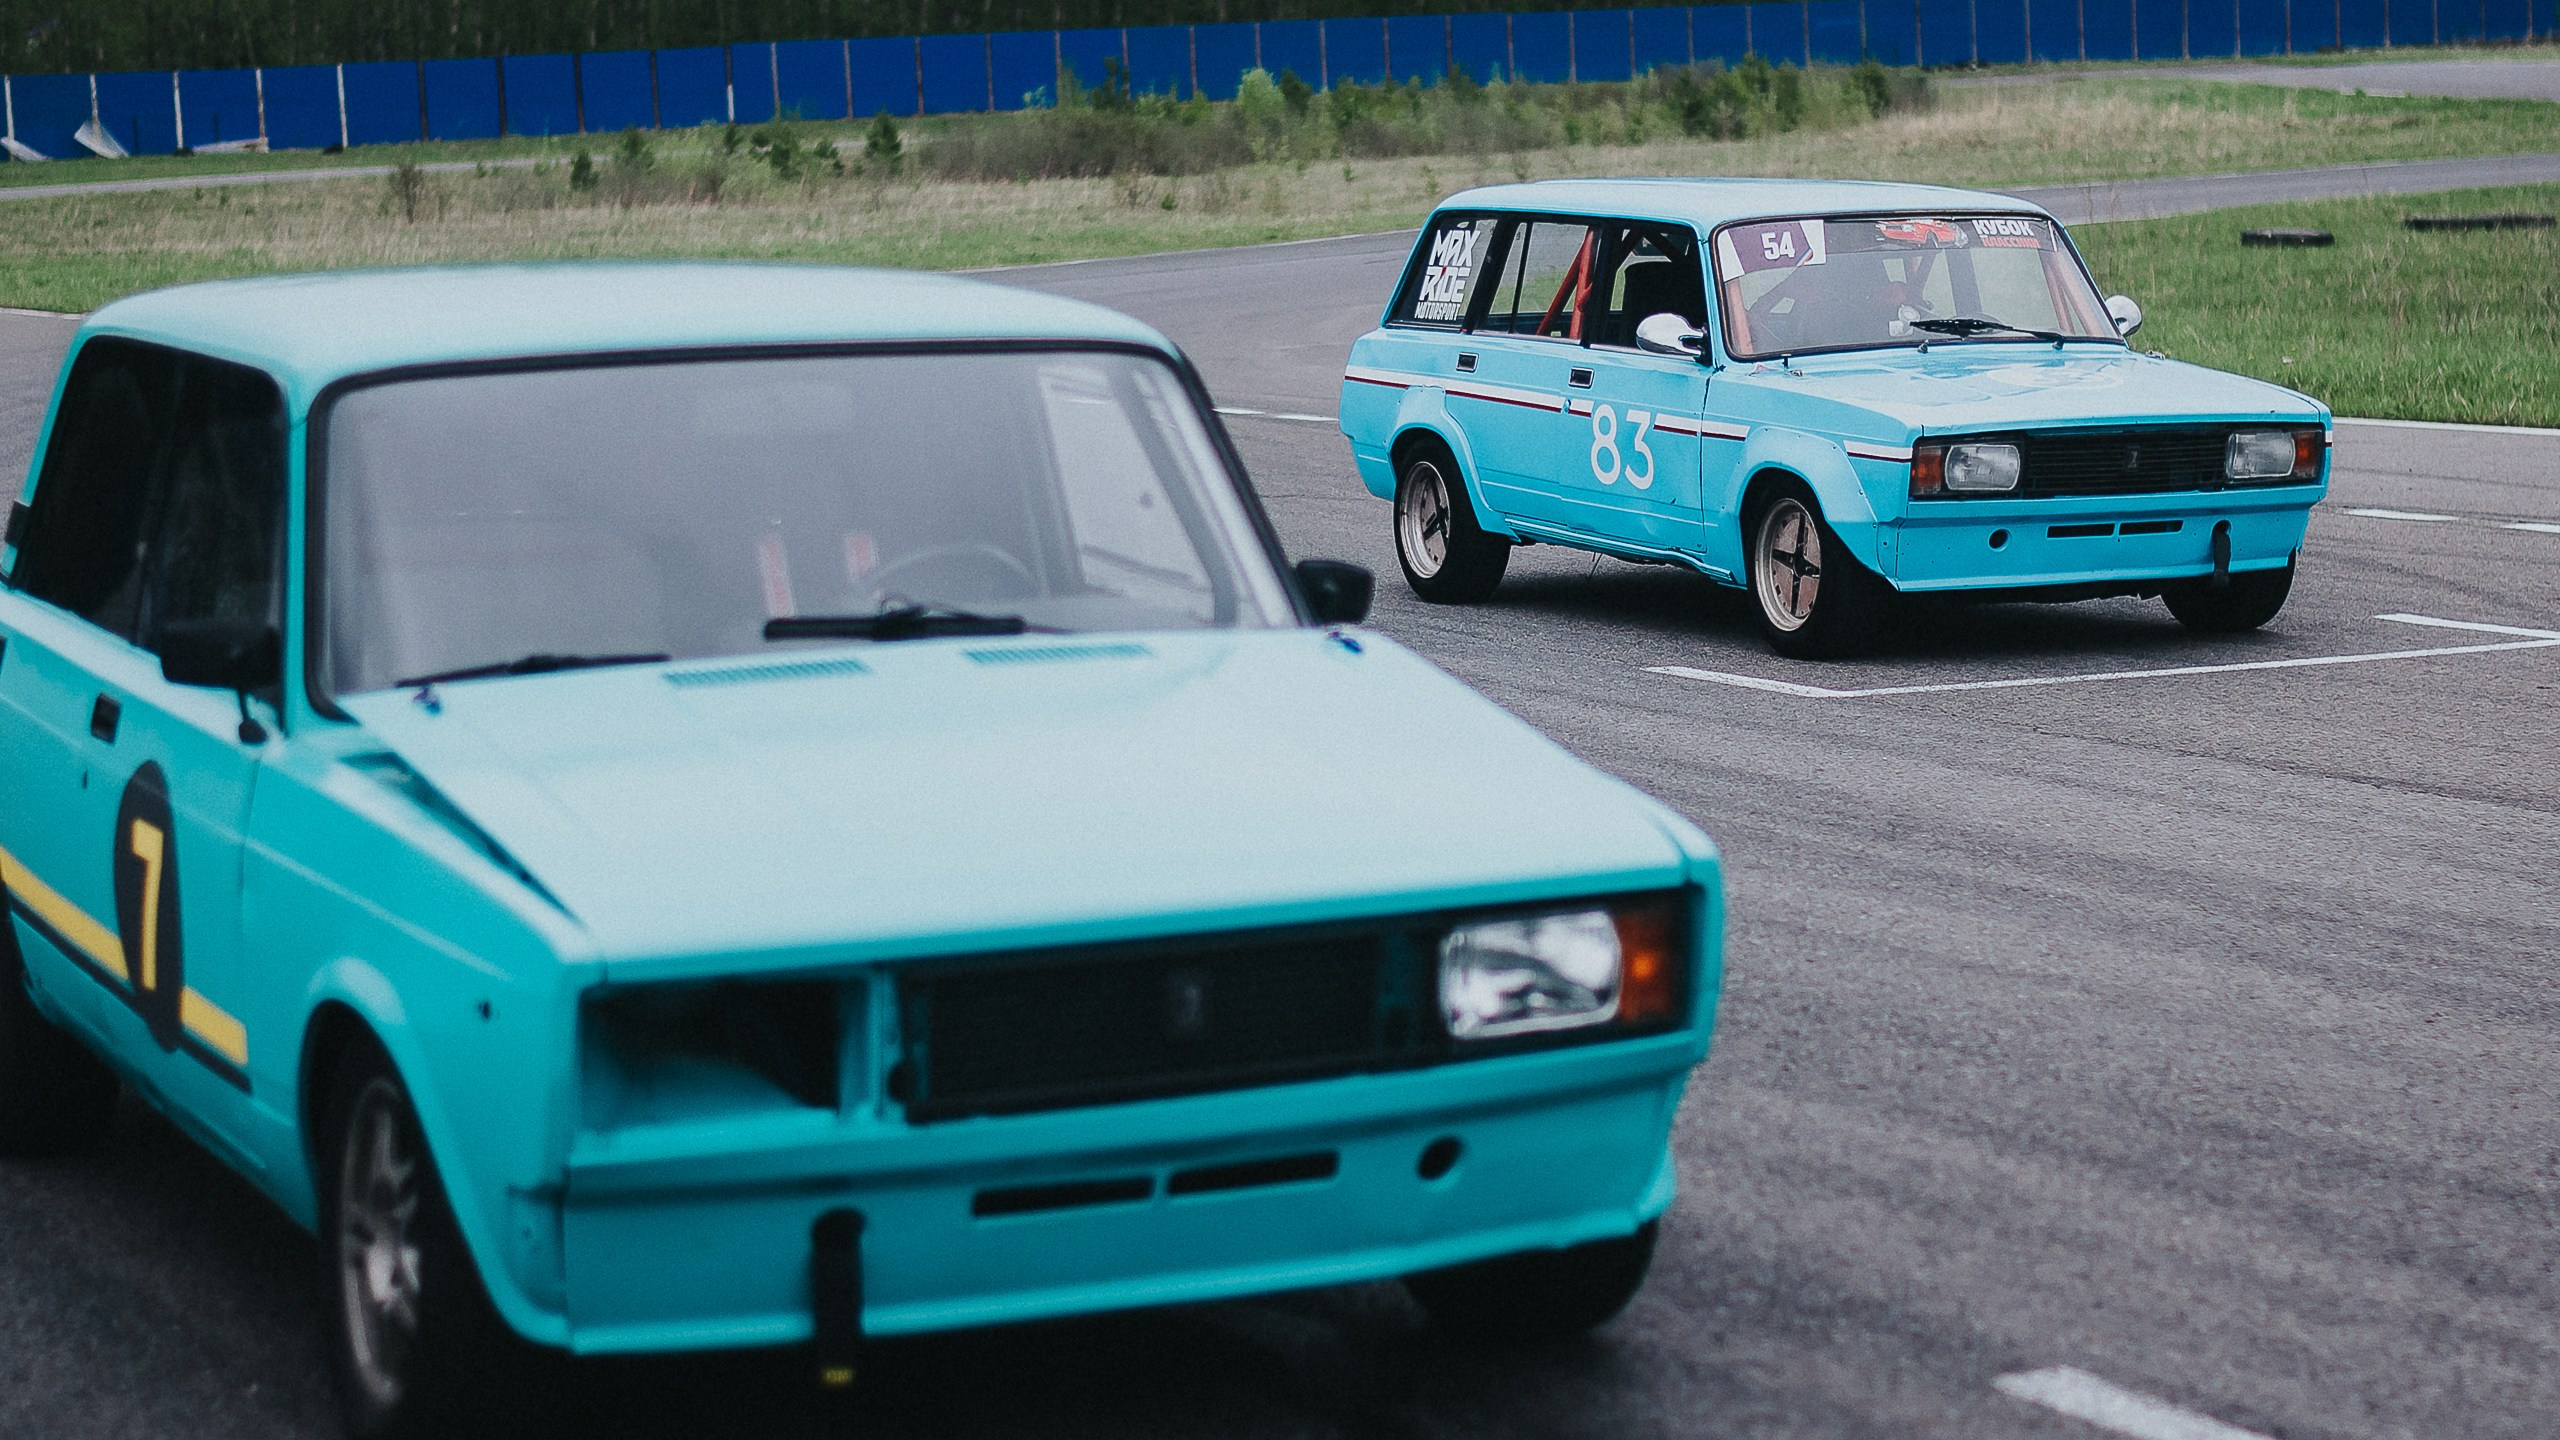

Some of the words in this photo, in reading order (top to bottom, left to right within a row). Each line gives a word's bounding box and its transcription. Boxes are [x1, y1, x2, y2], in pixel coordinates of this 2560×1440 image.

[1761, 231, 1796, 260] 54
[1972, 219, 2034, 237] КУБОК
[1429, 230, 1480, 267] MAX
[1419, 266, 1471, 303] RIDE
[1414, 301, 1461, 321] MOTORSPORT
[1590, 403, 1655, 490] 83
[131, 818, 164, 991] 7
